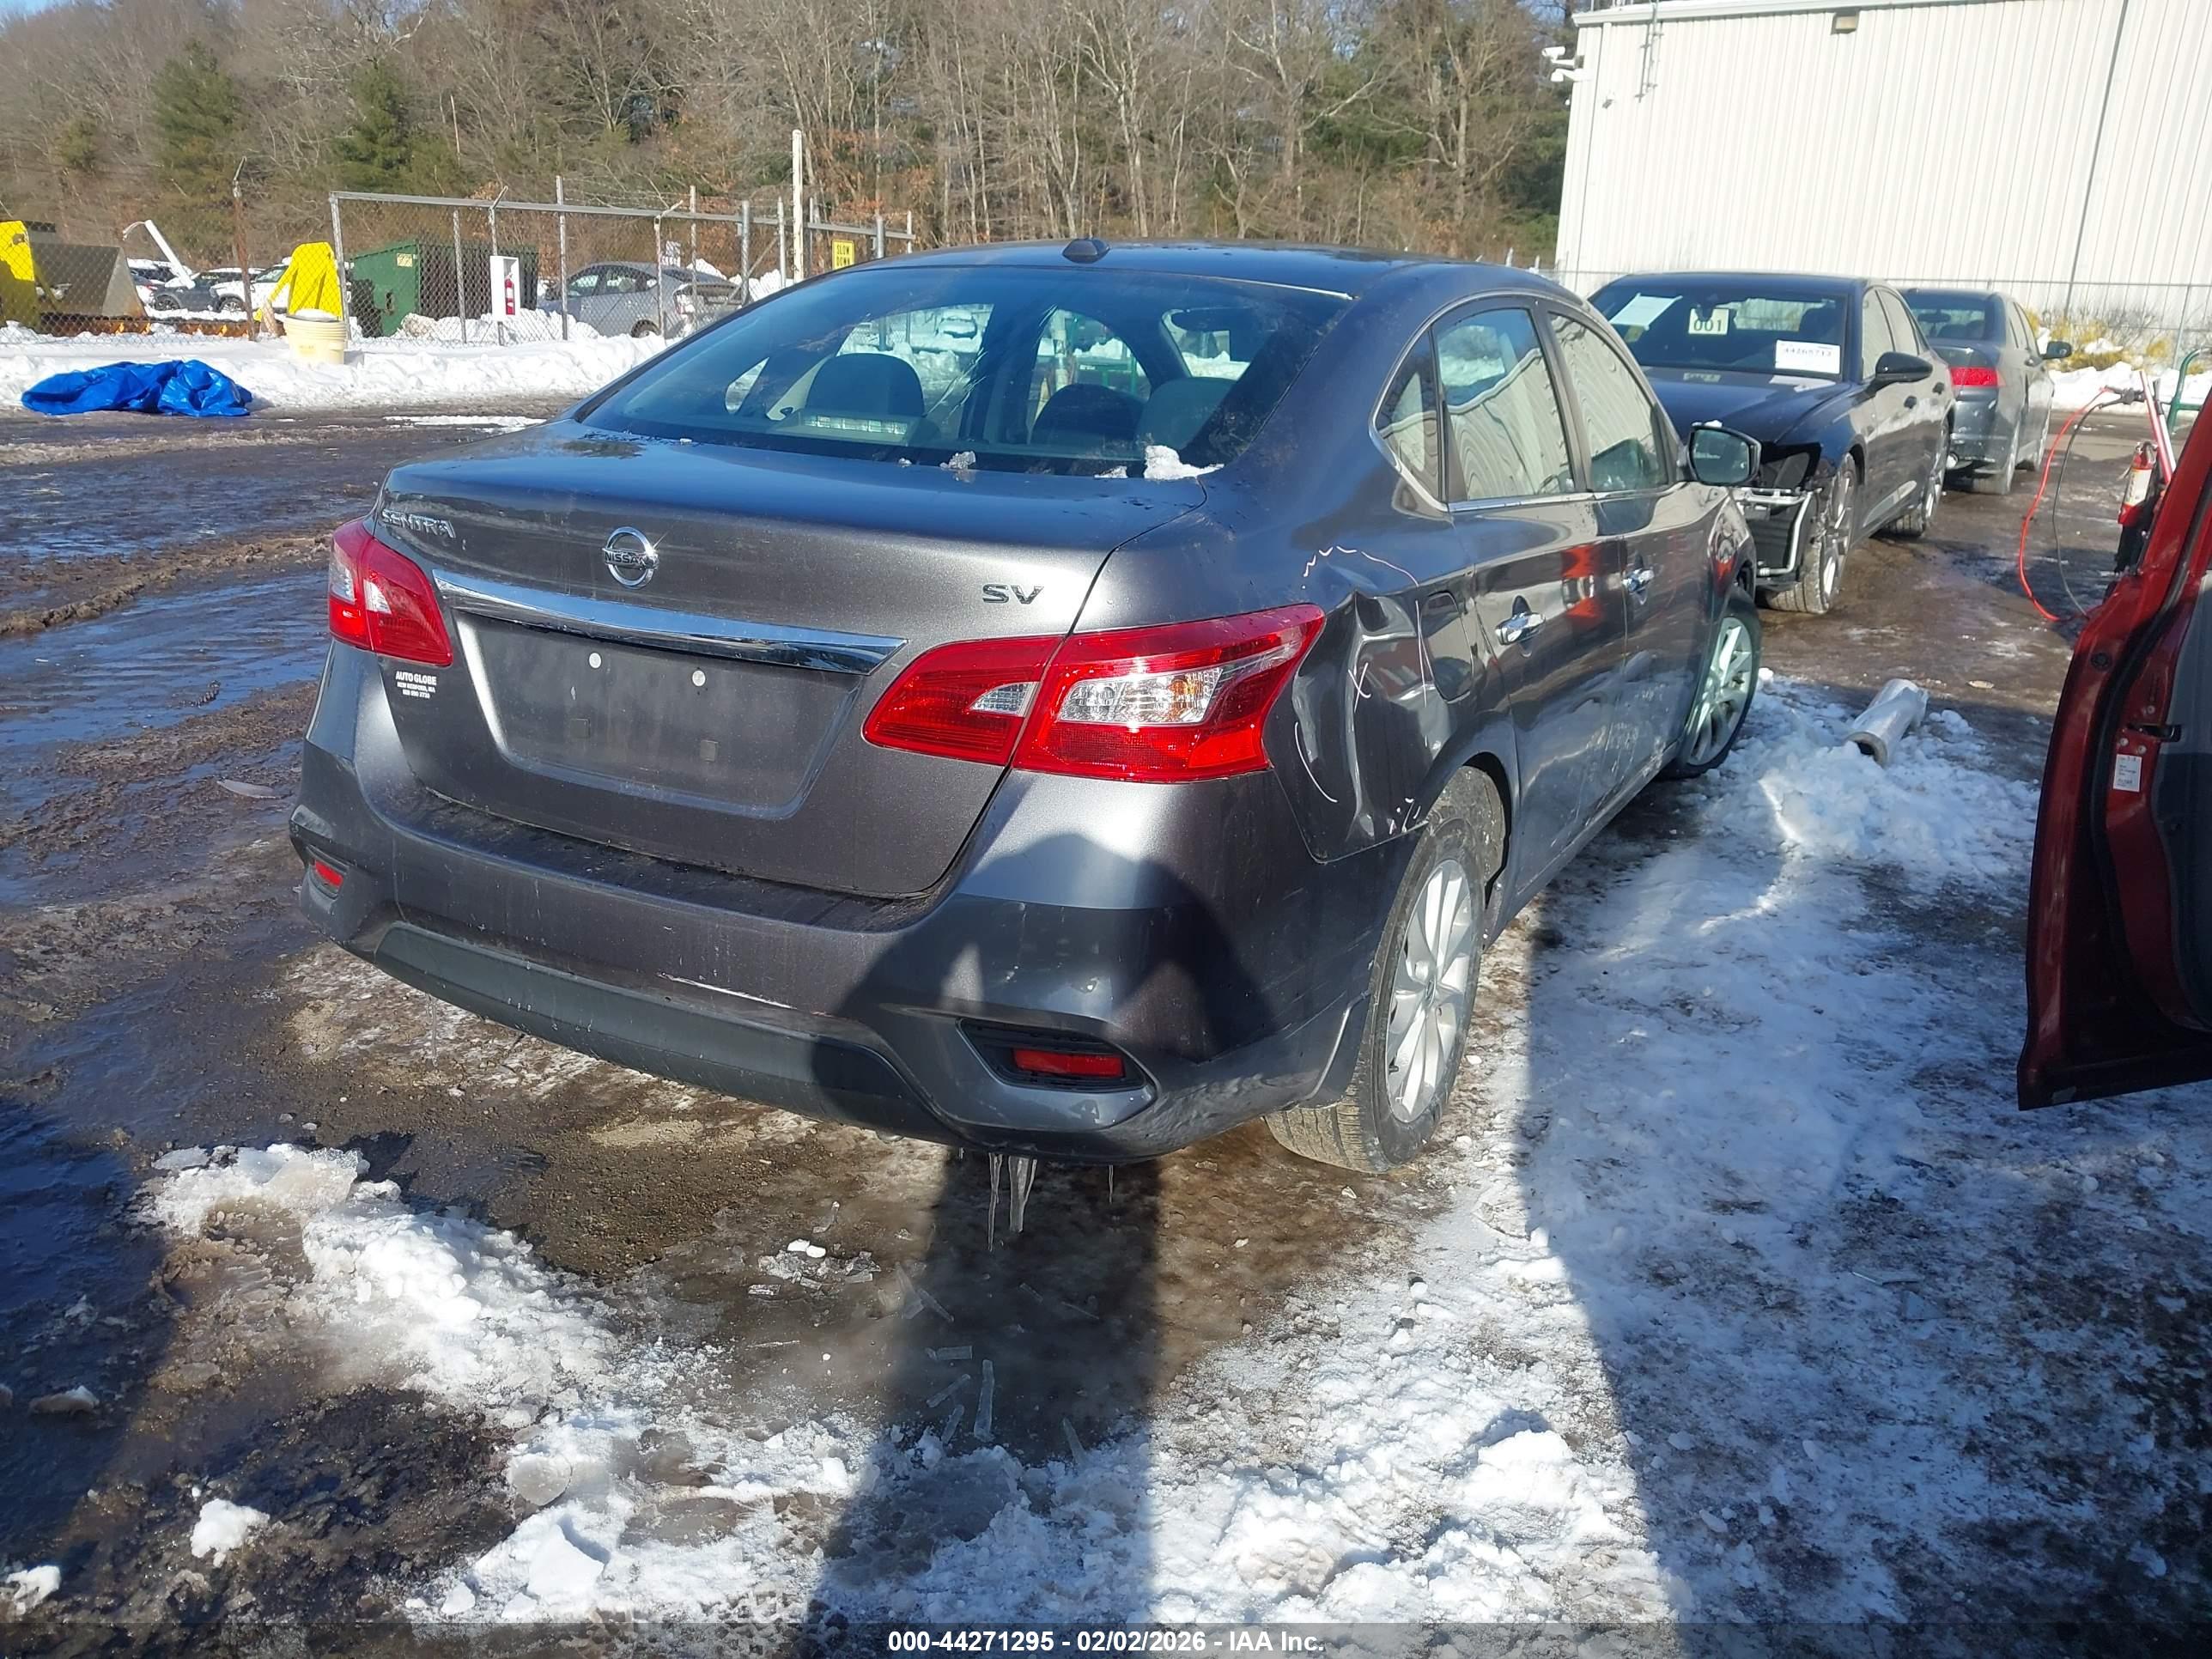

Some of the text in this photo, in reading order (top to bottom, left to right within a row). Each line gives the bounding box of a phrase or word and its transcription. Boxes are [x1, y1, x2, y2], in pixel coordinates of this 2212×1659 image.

[836, 244, 850, 255] SLOW
[1693, 319, 1722, 331] 001
[981, 584, 1044, 605] SV
[395, 671, 437, 686] AUTO GLOBE
